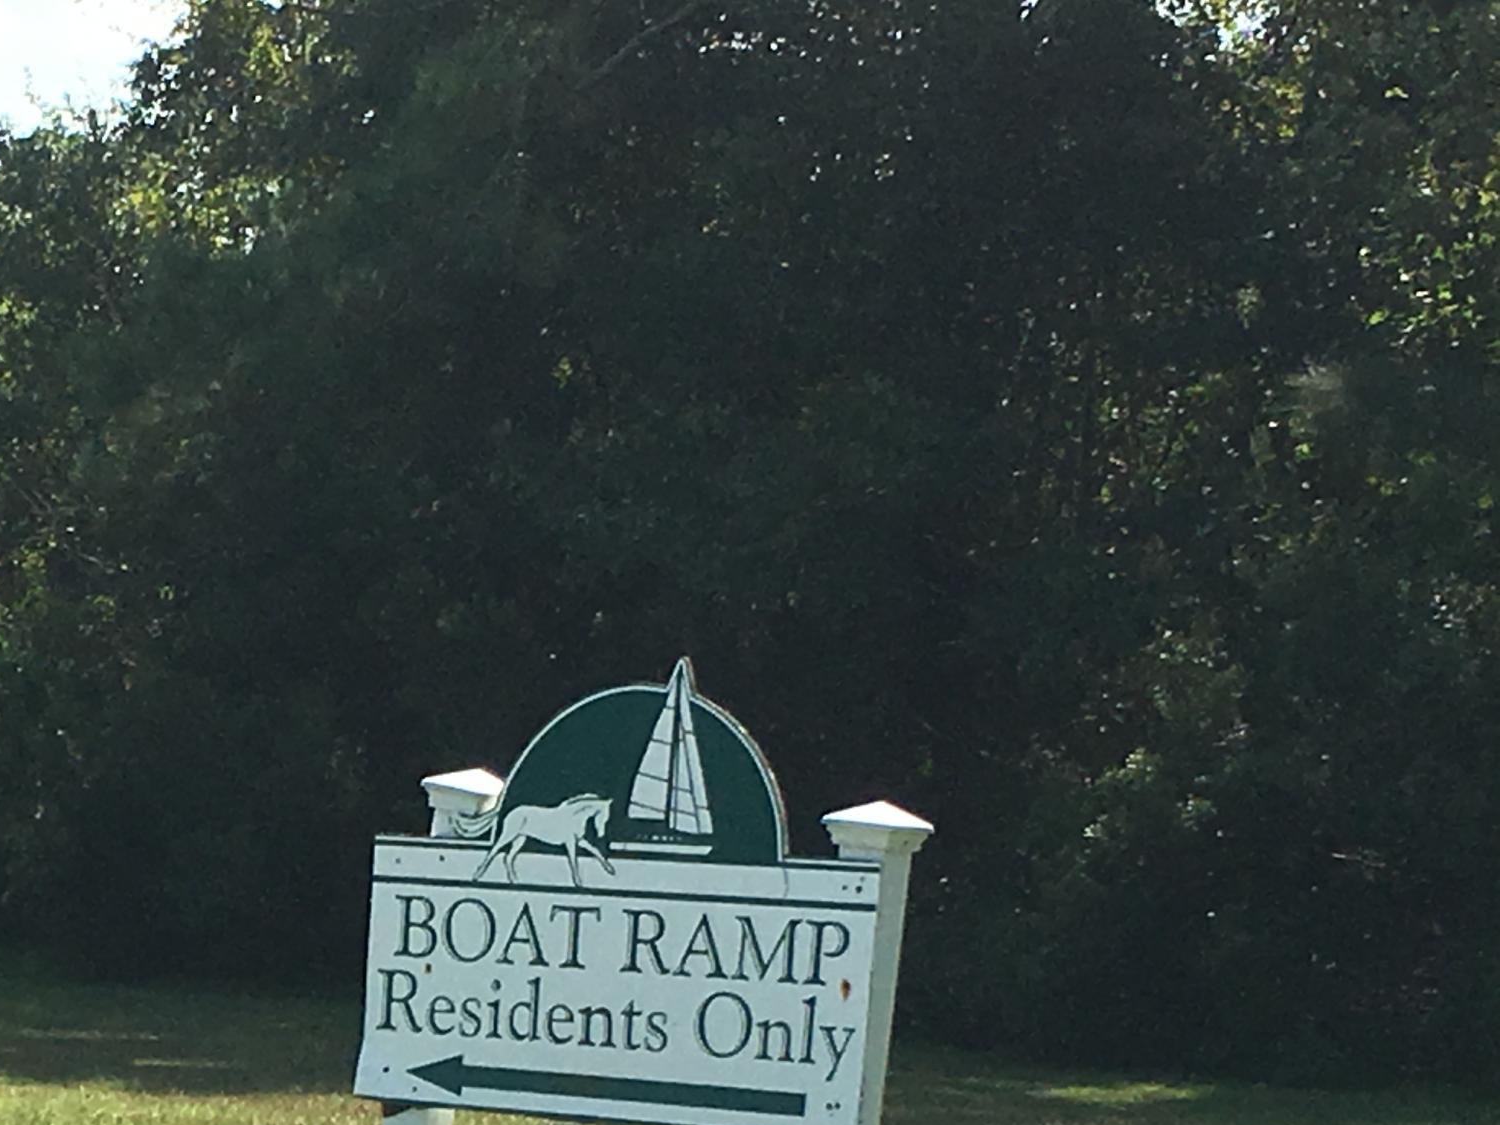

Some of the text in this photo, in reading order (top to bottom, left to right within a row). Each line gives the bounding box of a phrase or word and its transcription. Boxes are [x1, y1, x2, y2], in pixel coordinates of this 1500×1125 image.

[394, 895, 850, 986] BOAT RAMP
[376, 969, 855, 1081] Residents Only
